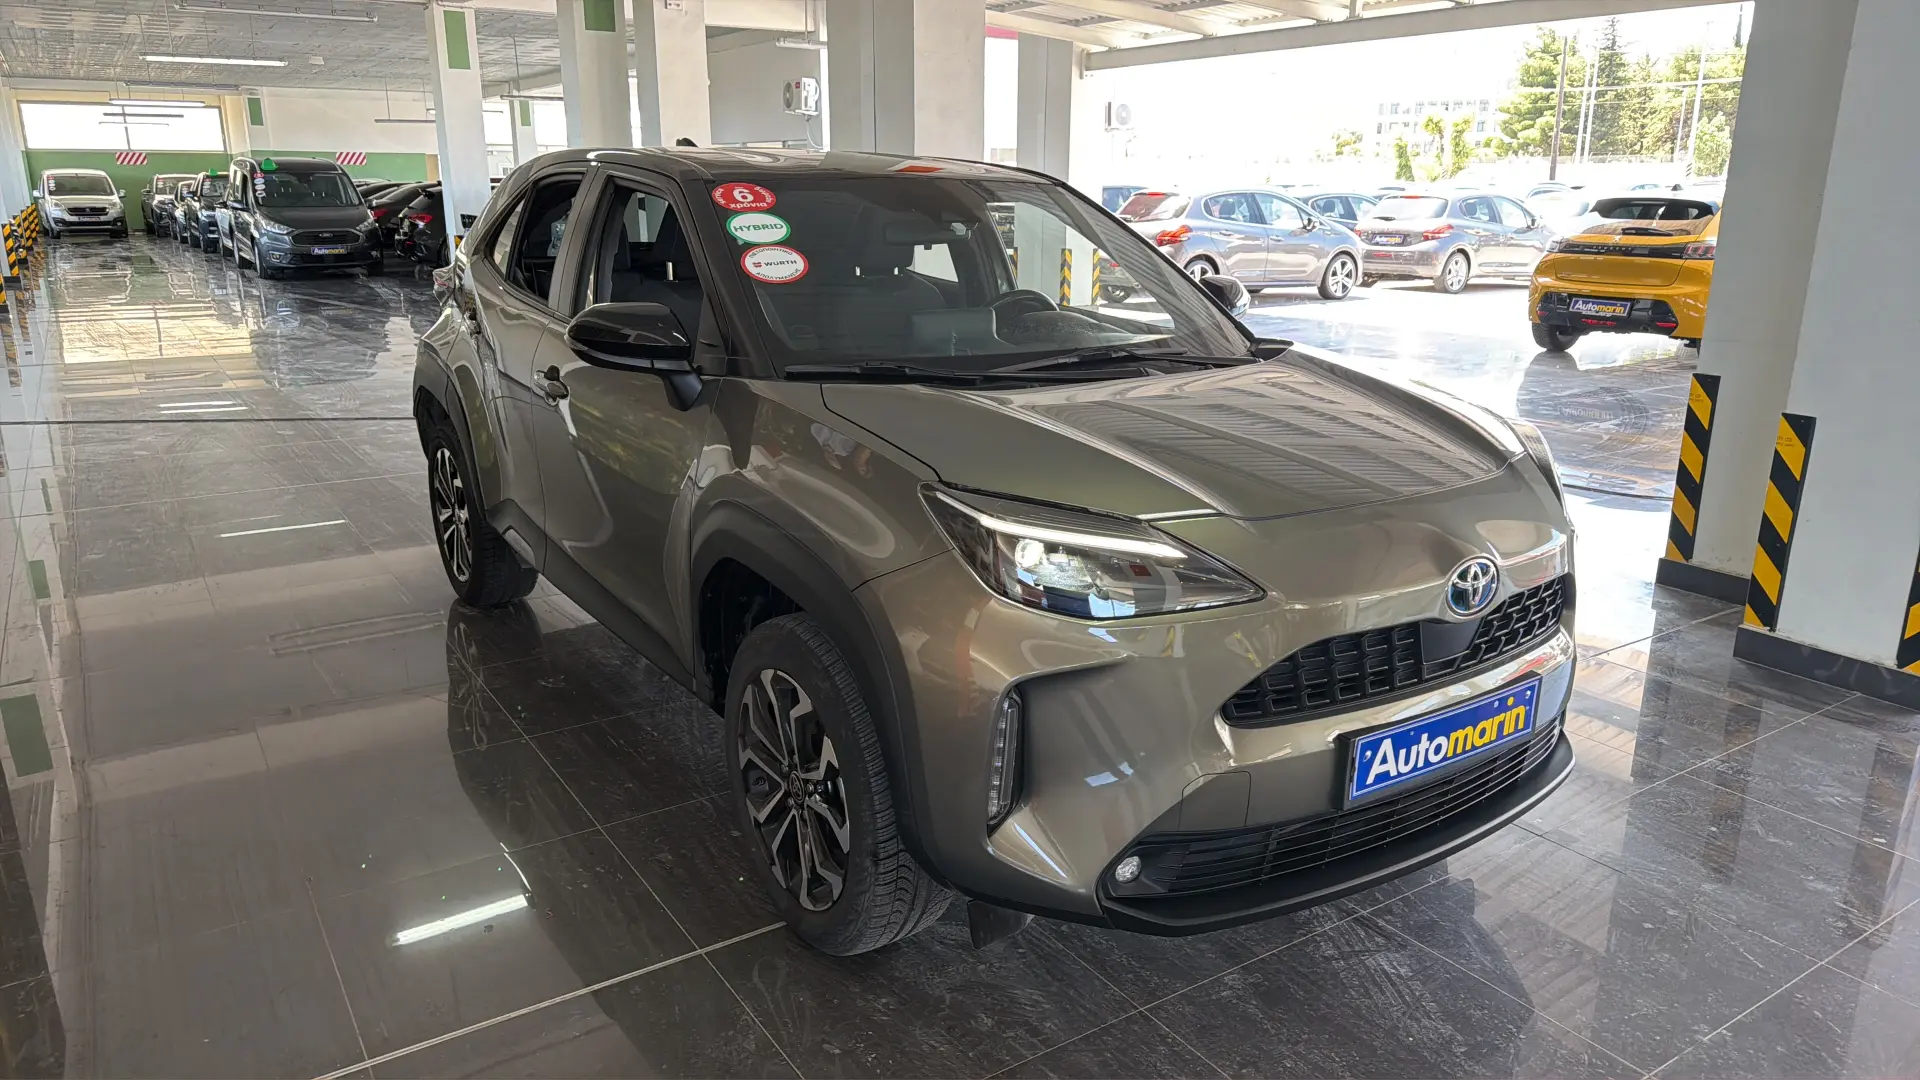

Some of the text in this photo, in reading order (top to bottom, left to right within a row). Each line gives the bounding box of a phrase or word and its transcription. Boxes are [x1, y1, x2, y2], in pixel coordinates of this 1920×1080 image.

[732, 188, 754, 202] 6
[733, 223, 784, 232] HYBRID
[1574, 300, 1625, 314] Automarin
[1365, 697, 1526, 785] Automarin
